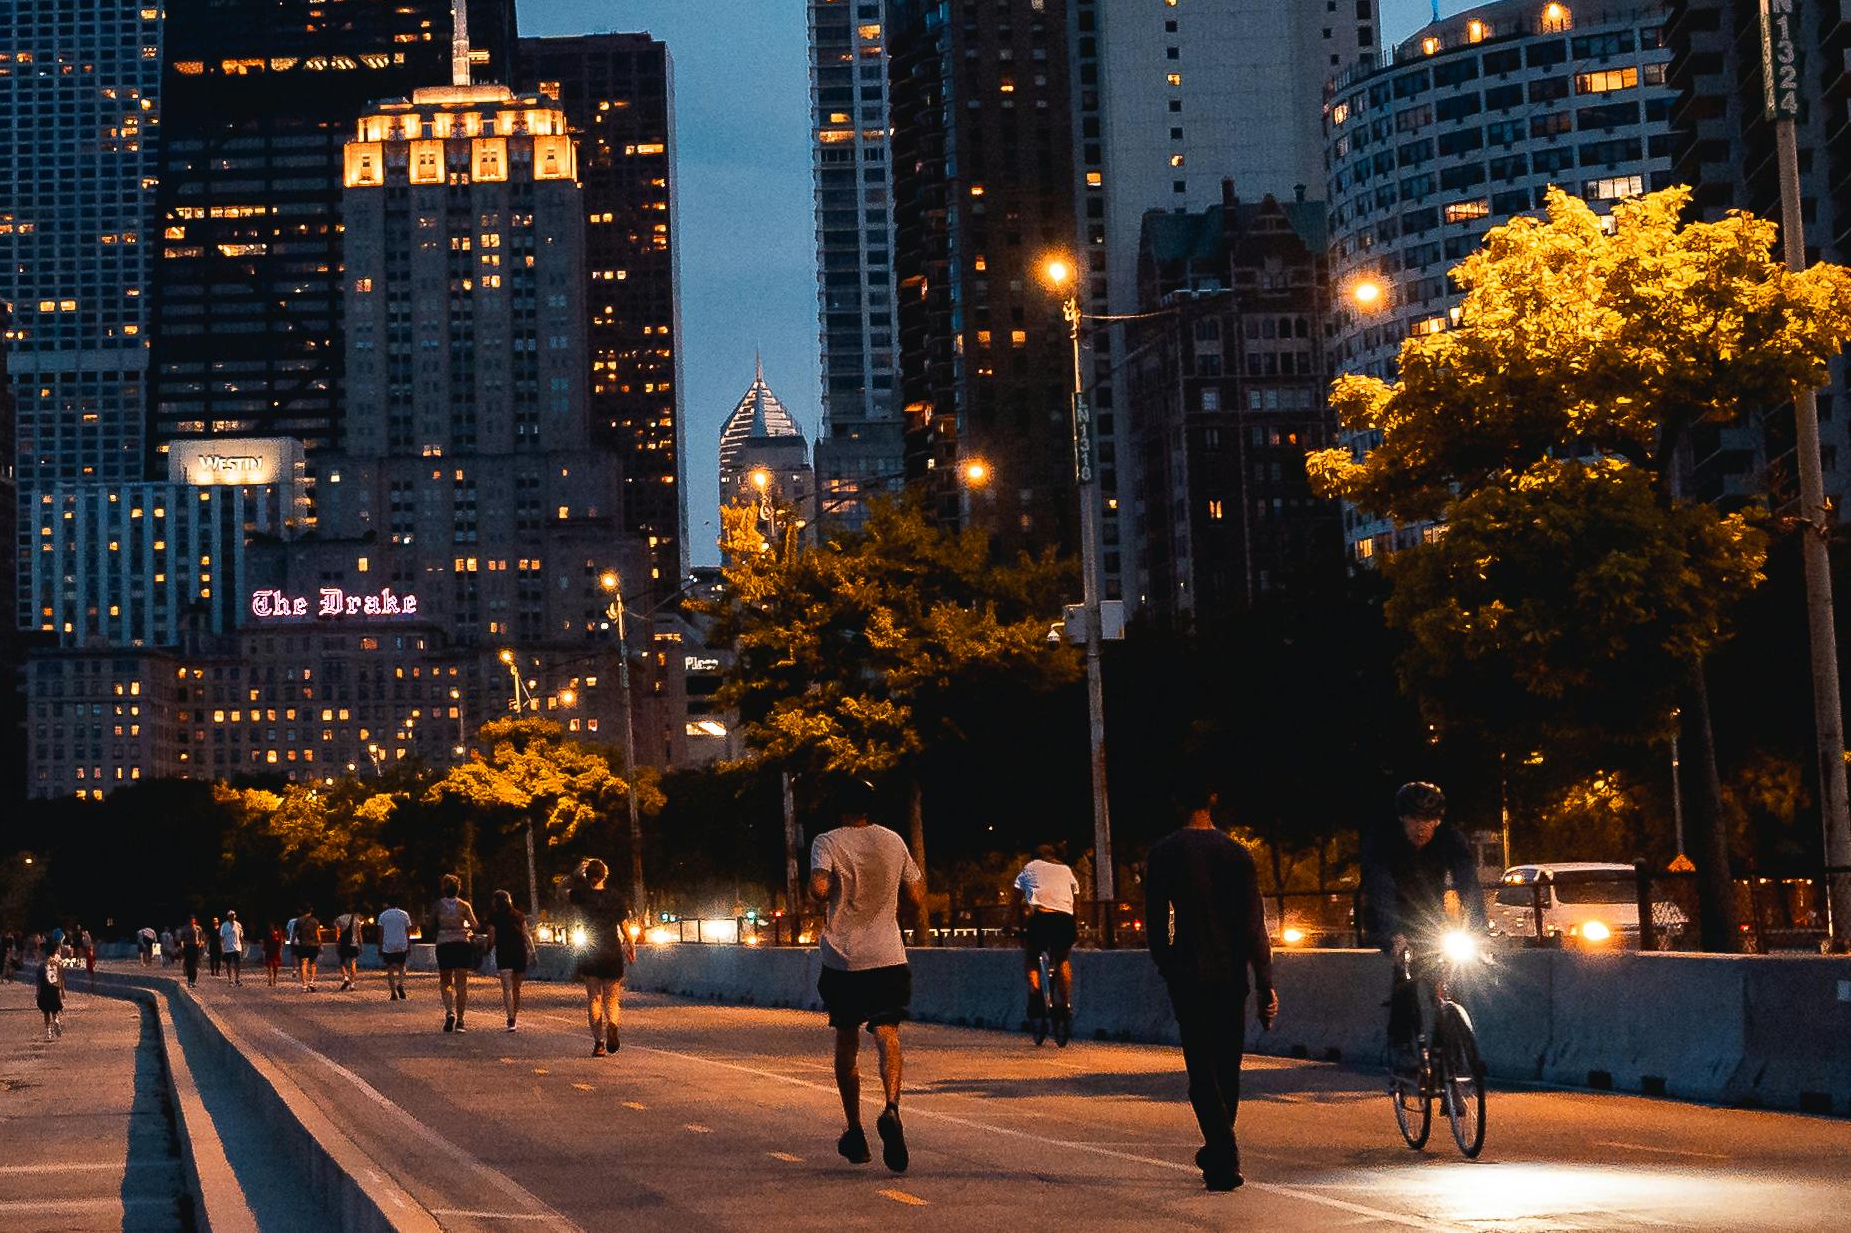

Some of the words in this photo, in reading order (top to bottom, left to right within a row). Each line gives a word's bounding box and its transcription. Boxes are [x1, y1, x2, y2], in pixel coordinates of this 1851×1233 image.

[198, 455, 262, 471] WESTIN
[252, 590, 308, 617] The
[318, 587, 417, 616] Drake
